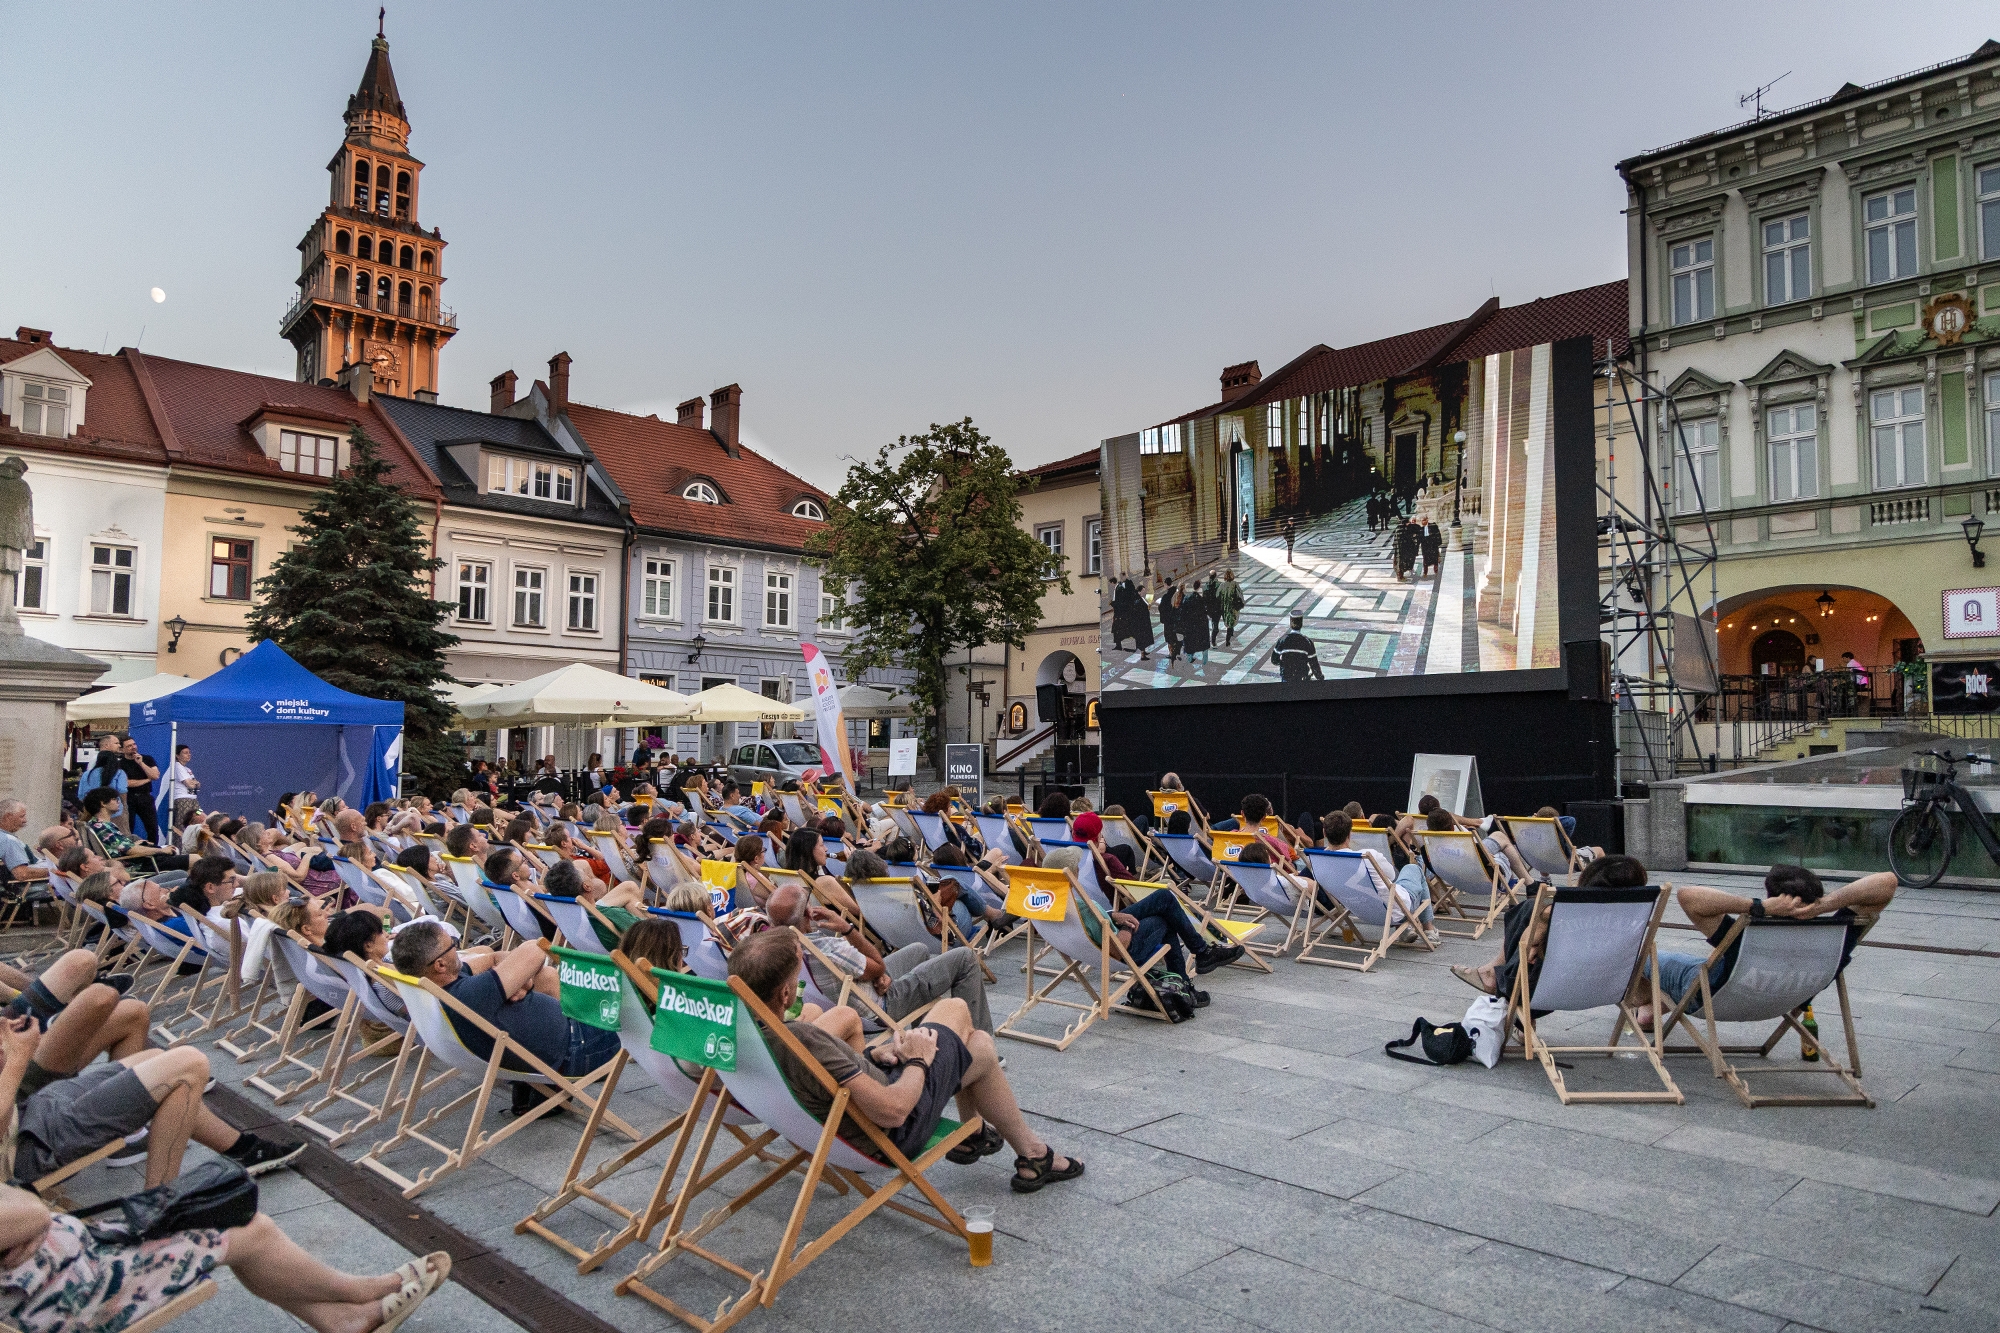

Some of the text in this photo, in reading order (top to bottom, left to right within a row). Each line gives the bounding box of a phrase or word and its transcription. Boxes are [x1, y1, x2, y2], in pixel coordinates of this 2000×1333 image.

[1965, 674, 1988, 694] ROCK
[276, 699, 309, 707] miejski
[298, 707, 330, 717] kultury
[950, 764, 973, 774] KINO
[1031, 895, 1050, 906] LOTTO
[559, 961, 620, 993] Heineken
[659, 985, 733, 1026] Heineken
